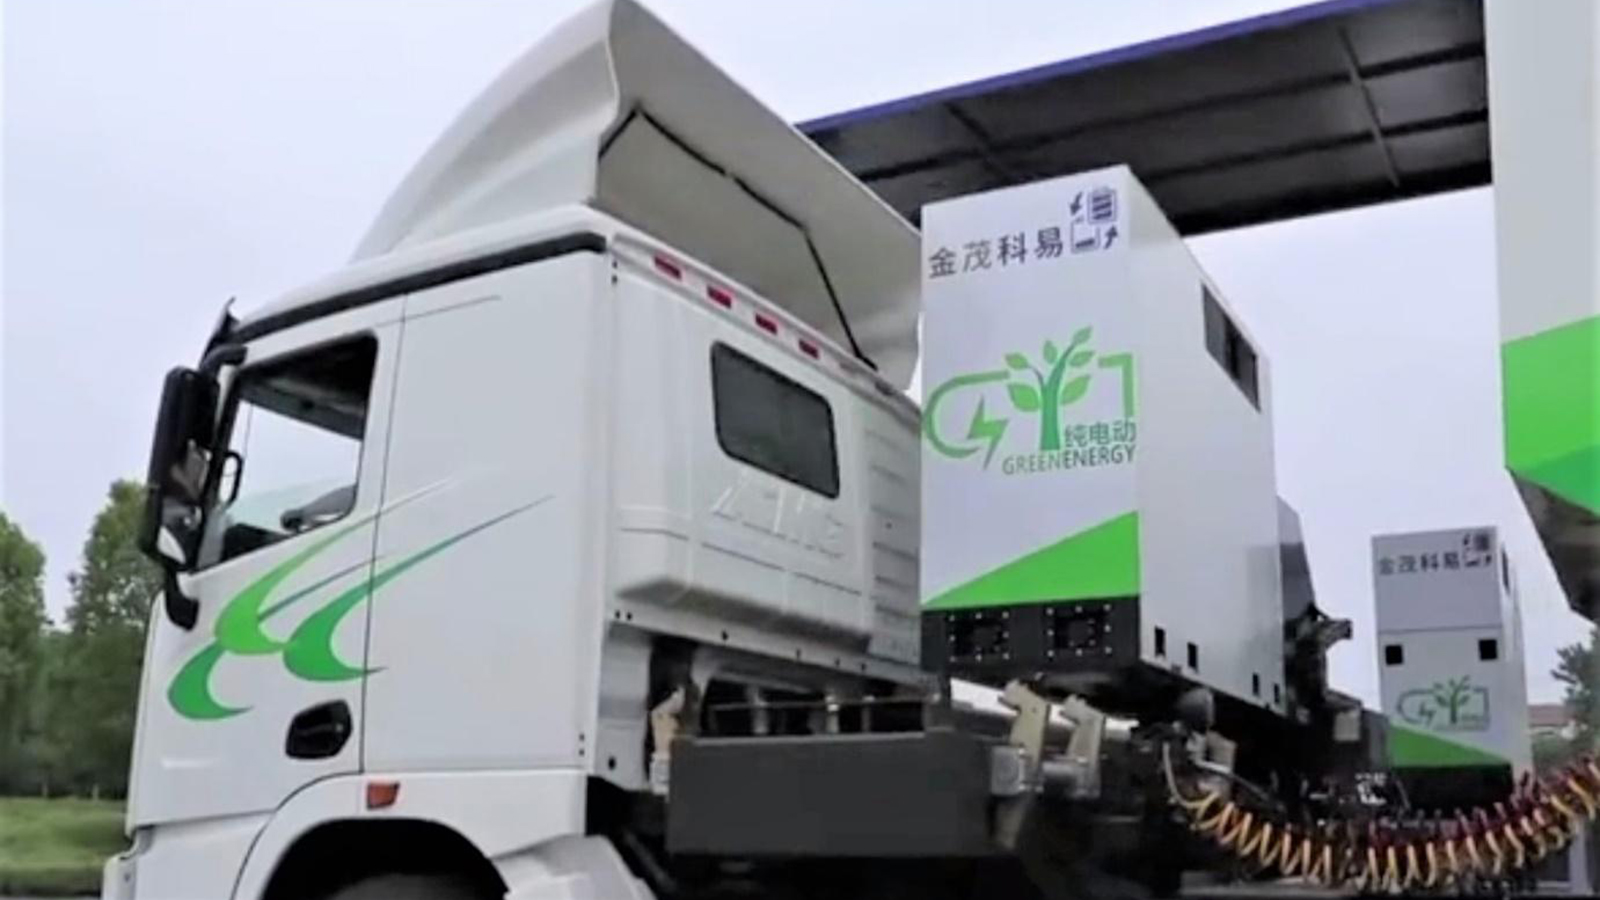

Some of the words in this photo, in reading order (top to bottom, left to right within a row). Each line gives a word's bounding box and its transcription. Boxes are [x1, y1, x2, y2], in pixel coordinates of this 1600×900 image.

[928, 226, 1063, 279] 金茂科易
[1064, 419, 1137, 448] 纯电动
